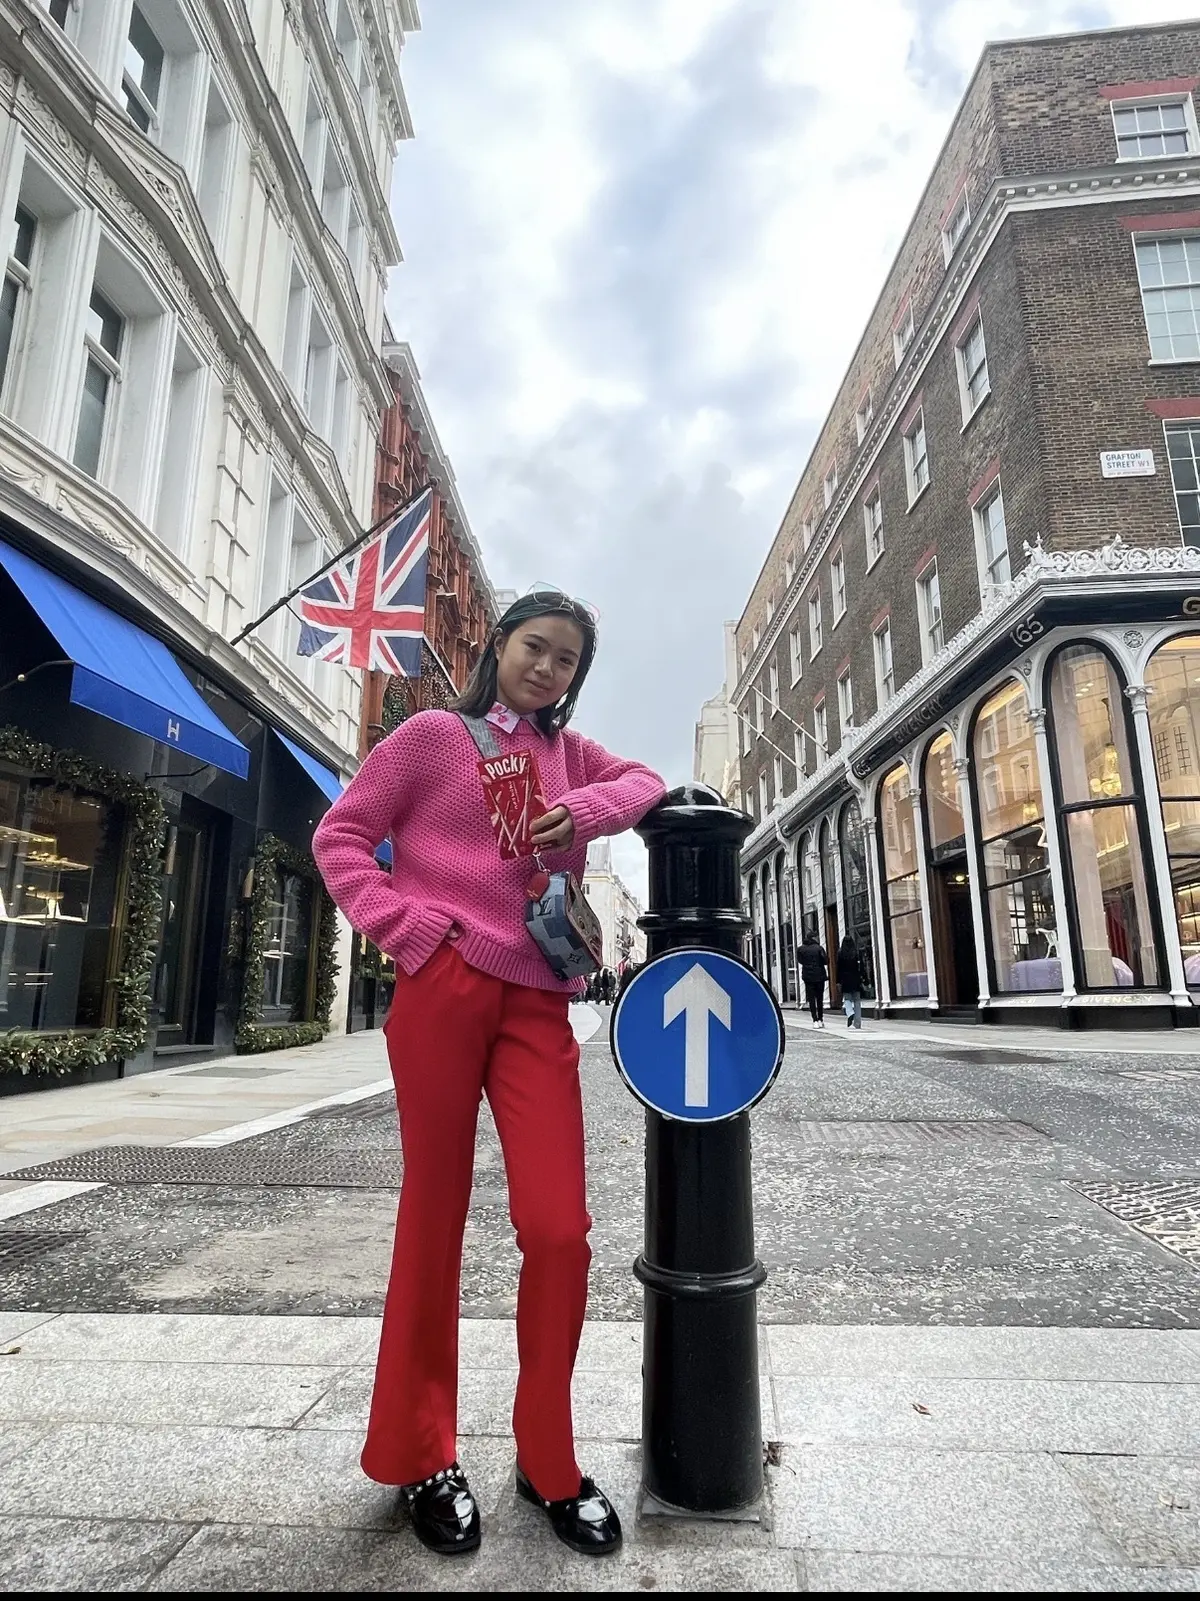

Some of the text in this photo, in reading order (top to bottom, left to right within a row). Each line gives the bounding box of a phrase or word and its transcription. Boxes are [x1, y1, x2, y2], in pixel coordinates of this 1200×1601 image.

[1106, 453, 1141, 461] GRAFTON
[1107, 460, 1135, 468] STREET
[1009, 612, 1044, 648] 165
[167, 718, 180, 742] H
[484, 754, 527, 780] Pocky
